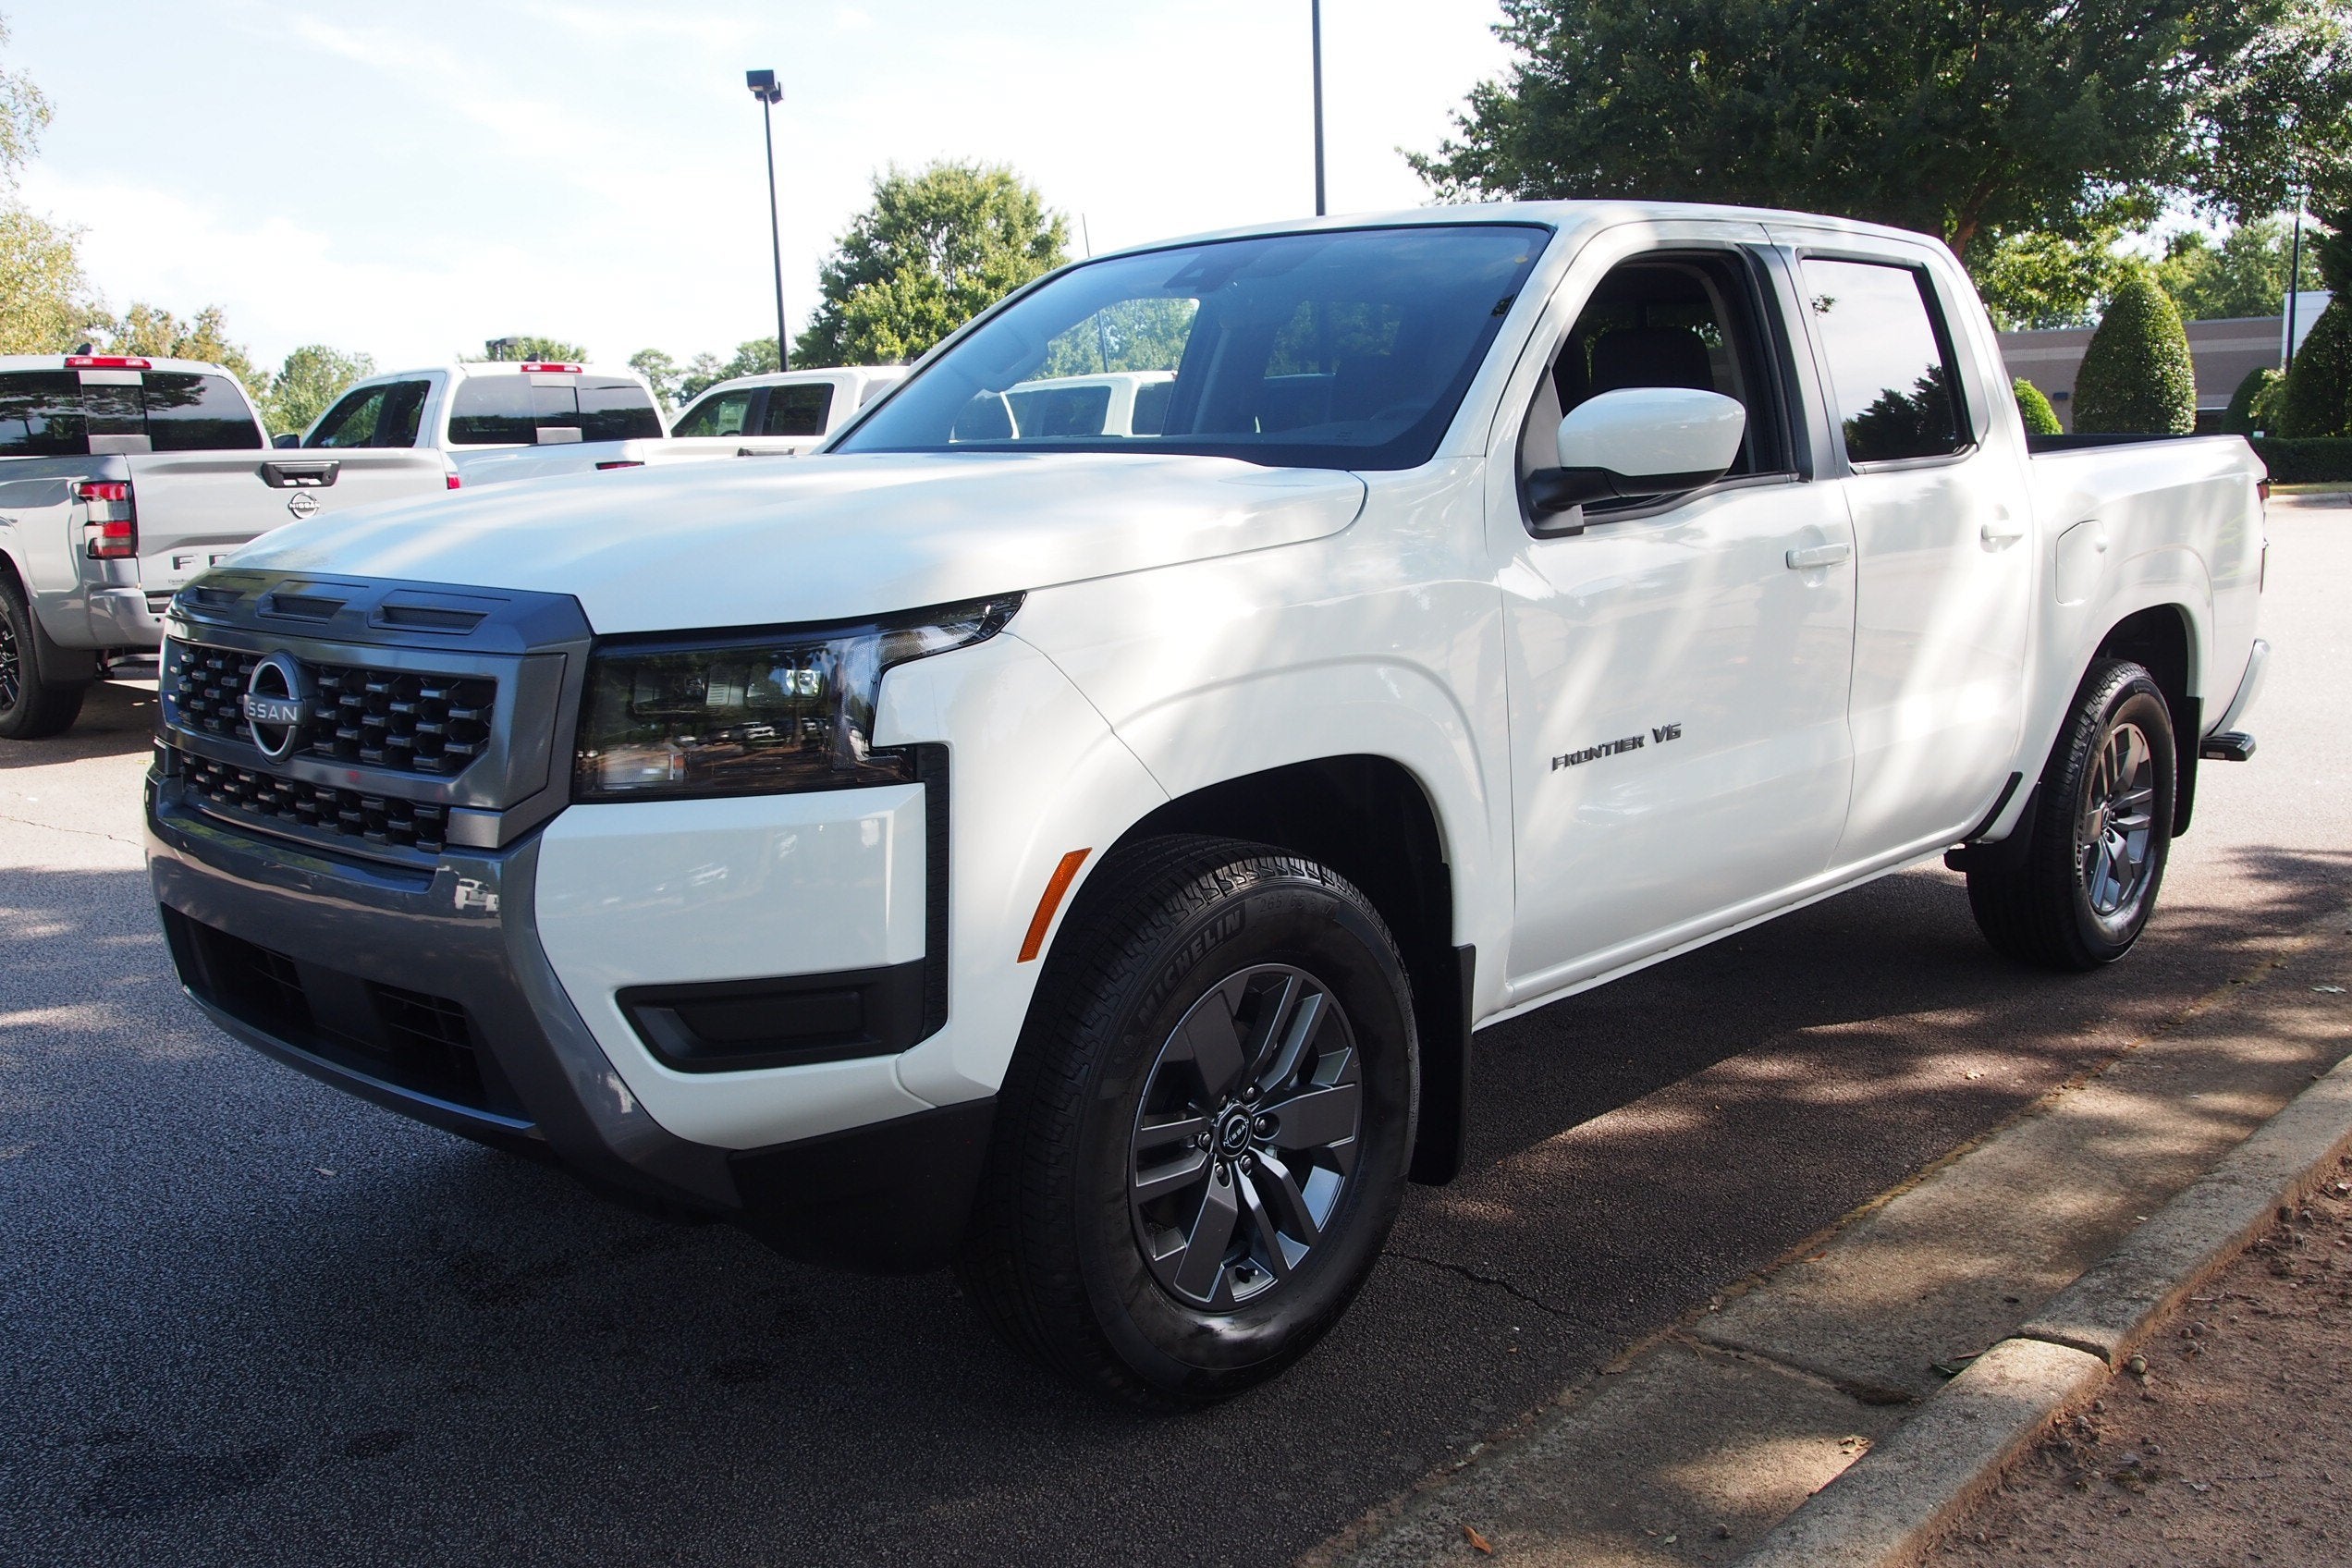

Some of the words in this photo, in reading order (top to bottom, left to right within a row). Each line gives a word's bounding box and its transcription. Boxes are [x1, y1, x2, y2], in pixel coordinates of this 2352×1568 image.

[1551, 735, 1645, 771] FRONTIER
[1652, 722, 1682, 743] V6
[1138, 911, 1241, 1023] MICHELIN
[1222, 1118, 1249, 1146] NISSAN
